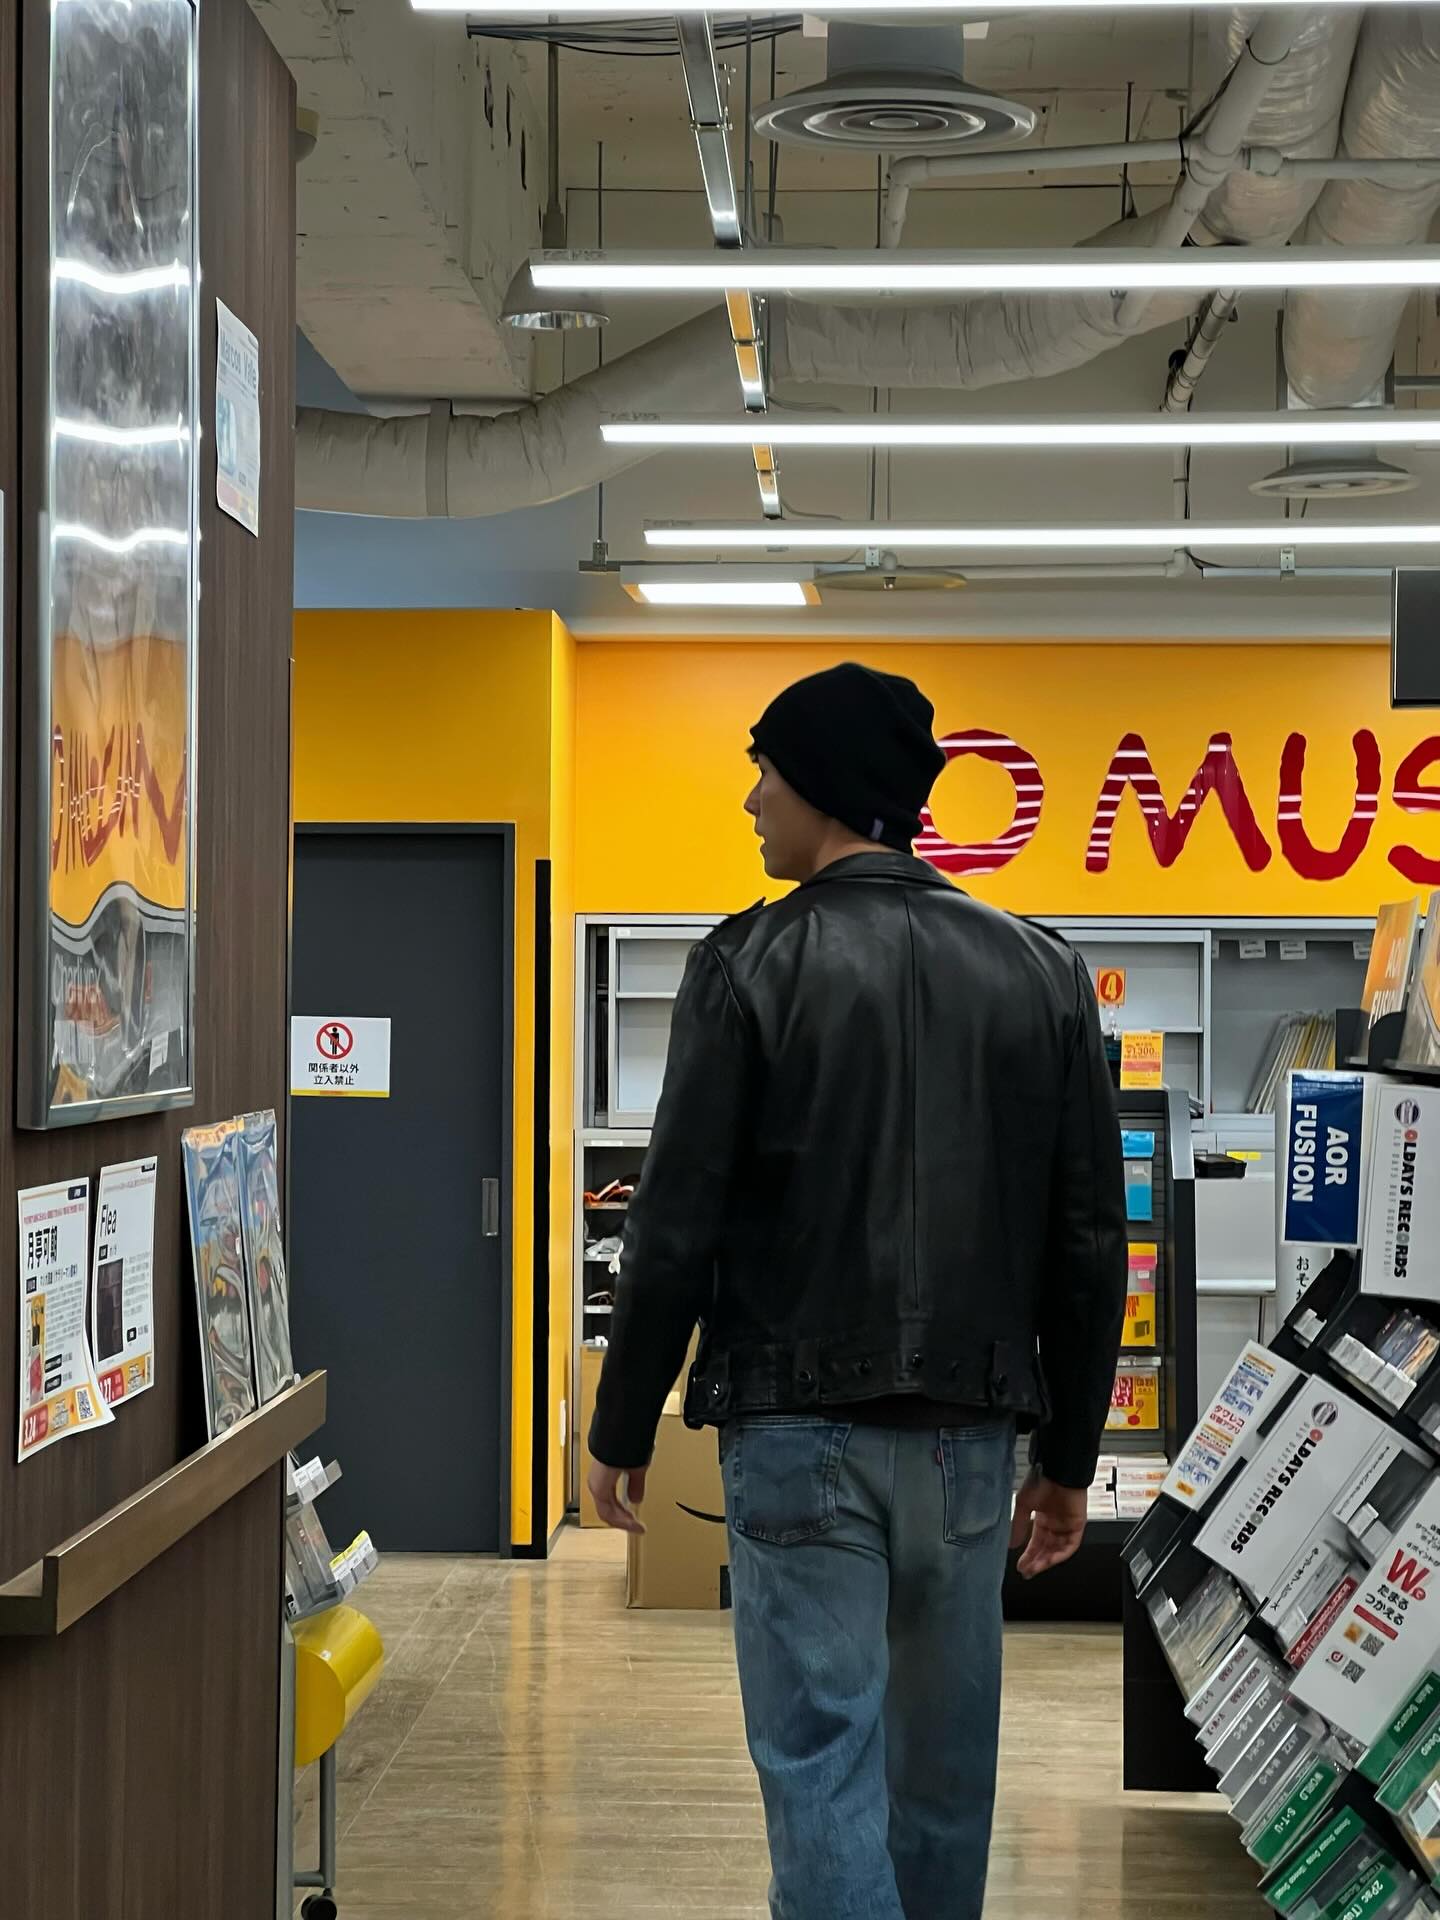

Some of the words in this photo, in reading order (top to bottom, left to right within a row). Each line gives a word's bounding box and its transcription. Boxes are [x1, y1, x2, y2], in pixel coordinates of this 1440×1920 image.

[1105, 974, 1118, 1000] 4
[308, 1062, 359, 1074] 関係者以外
[313, 1075, 355, 1086] 立入禁止
[1292, 1104, 1317, 1203] FUSION
[1324, 1125, 1349, 1186] AOR
[1400, 1128, 1418, 1196] OLDAYS
[99, 1203, 118, 1238] Flea
[1393, 1200, 1413, 1278] RECORDS
[1214, 1404, 1245, 1428] タワレコ
[1279, 1429, 1323, 1488] OLDAYS
[1231, 1483, 1284, 1555] RECORDS
[1365, 1589, 1405, 1626] つかえる
[1377, 1584, 1409, 1611] たまる
[1255, 1689, 1272, 1709] JAZZ
[1267, 1711, 1284, 1731] JAZZ
[1393, 1703, 1418, 1733] Source
[1281, 1732, 1299, 1754] JAZZ
[1419, 1732, 1440, 1757] Deep
[1298, 1770, 1323, 1800] WORLD
[1360, 1879, 1383, 1905] 2Pac
